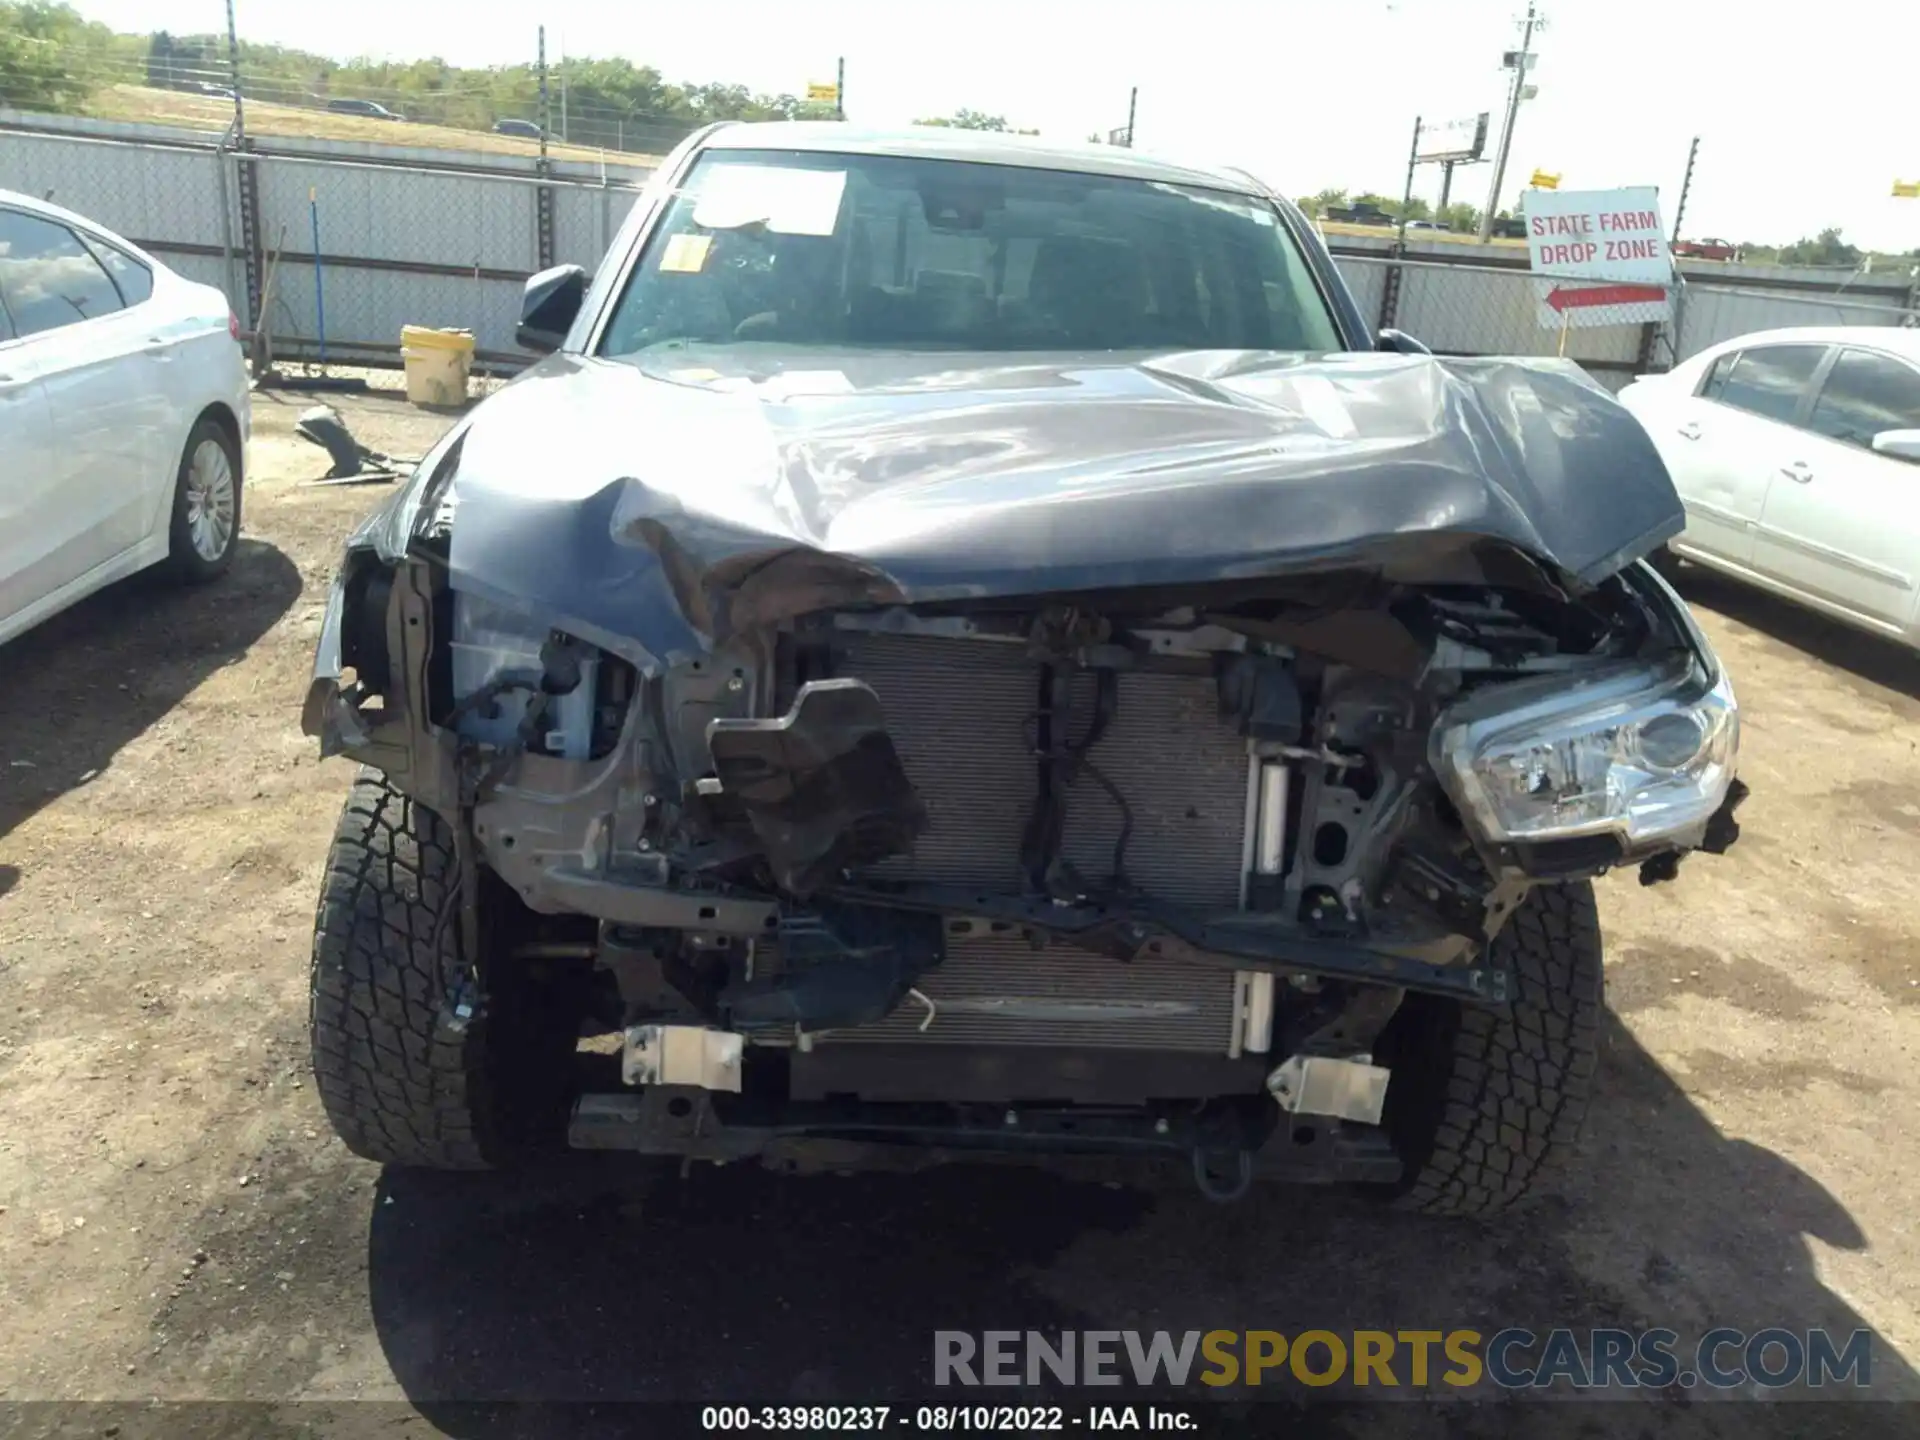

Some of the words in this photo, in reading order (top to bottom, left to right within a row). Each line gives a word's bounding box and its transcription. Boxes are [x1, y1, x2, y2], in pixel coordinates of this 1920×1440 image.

[1532, 214, 1593, 236] STATE
[1599, 211, 1658, 231] FARM
[1540, 243, 1597, 265] DROP
[1604, 239, 1659, 261] ZONE
